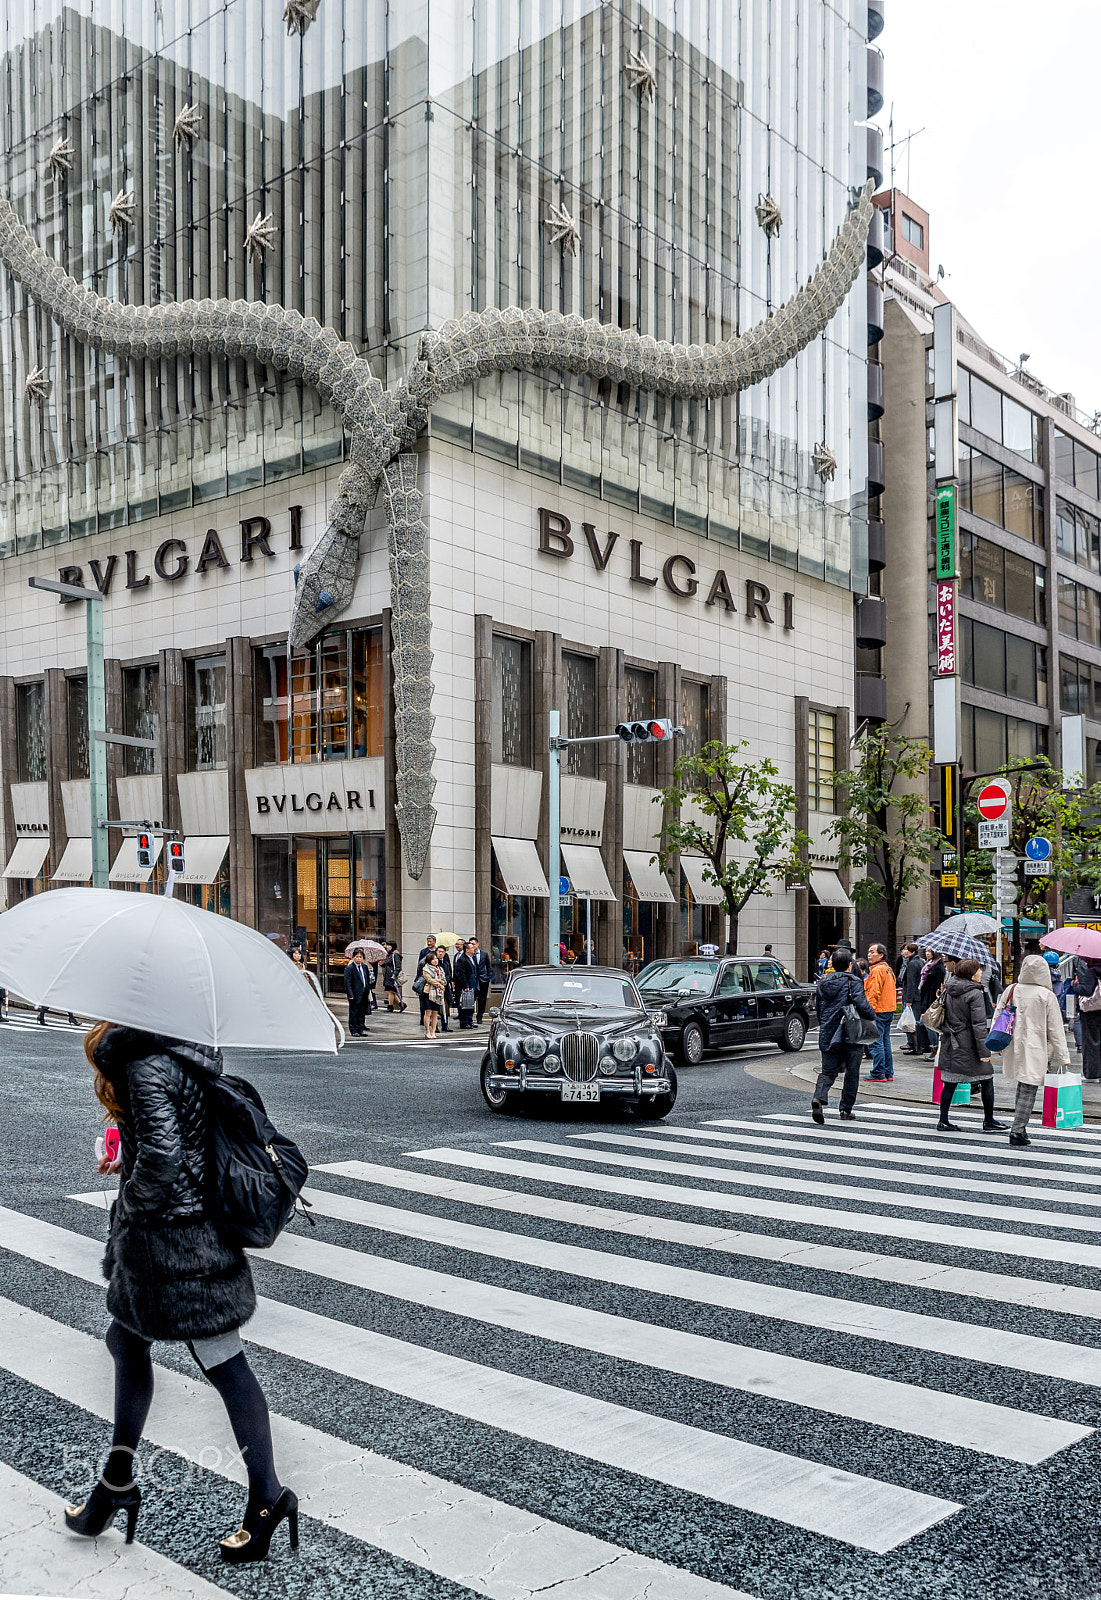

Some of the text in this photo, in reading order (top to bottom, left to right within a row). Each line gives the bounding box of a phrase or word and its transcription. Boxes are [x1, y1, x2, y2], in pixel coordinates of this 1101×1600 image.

[940, 501, 951, 572] 銀座マロニエ通り歯科
[58, 504, 303, 604] BVLGARI
[537, 507, 796, 631] BVLGARI
[939, 585, 954, 672] おいだ美術
[256, 789, 377, 814] BVLGARI
[16, 823, 49, 831] BVLGAR
[560, 827, 601, 838] BVLGARI
[508, 883, 548, 893] BVLGARI
[640, 891, 672, 899] BVLGARI
[570, 1090, 598, 1101] 74-92
